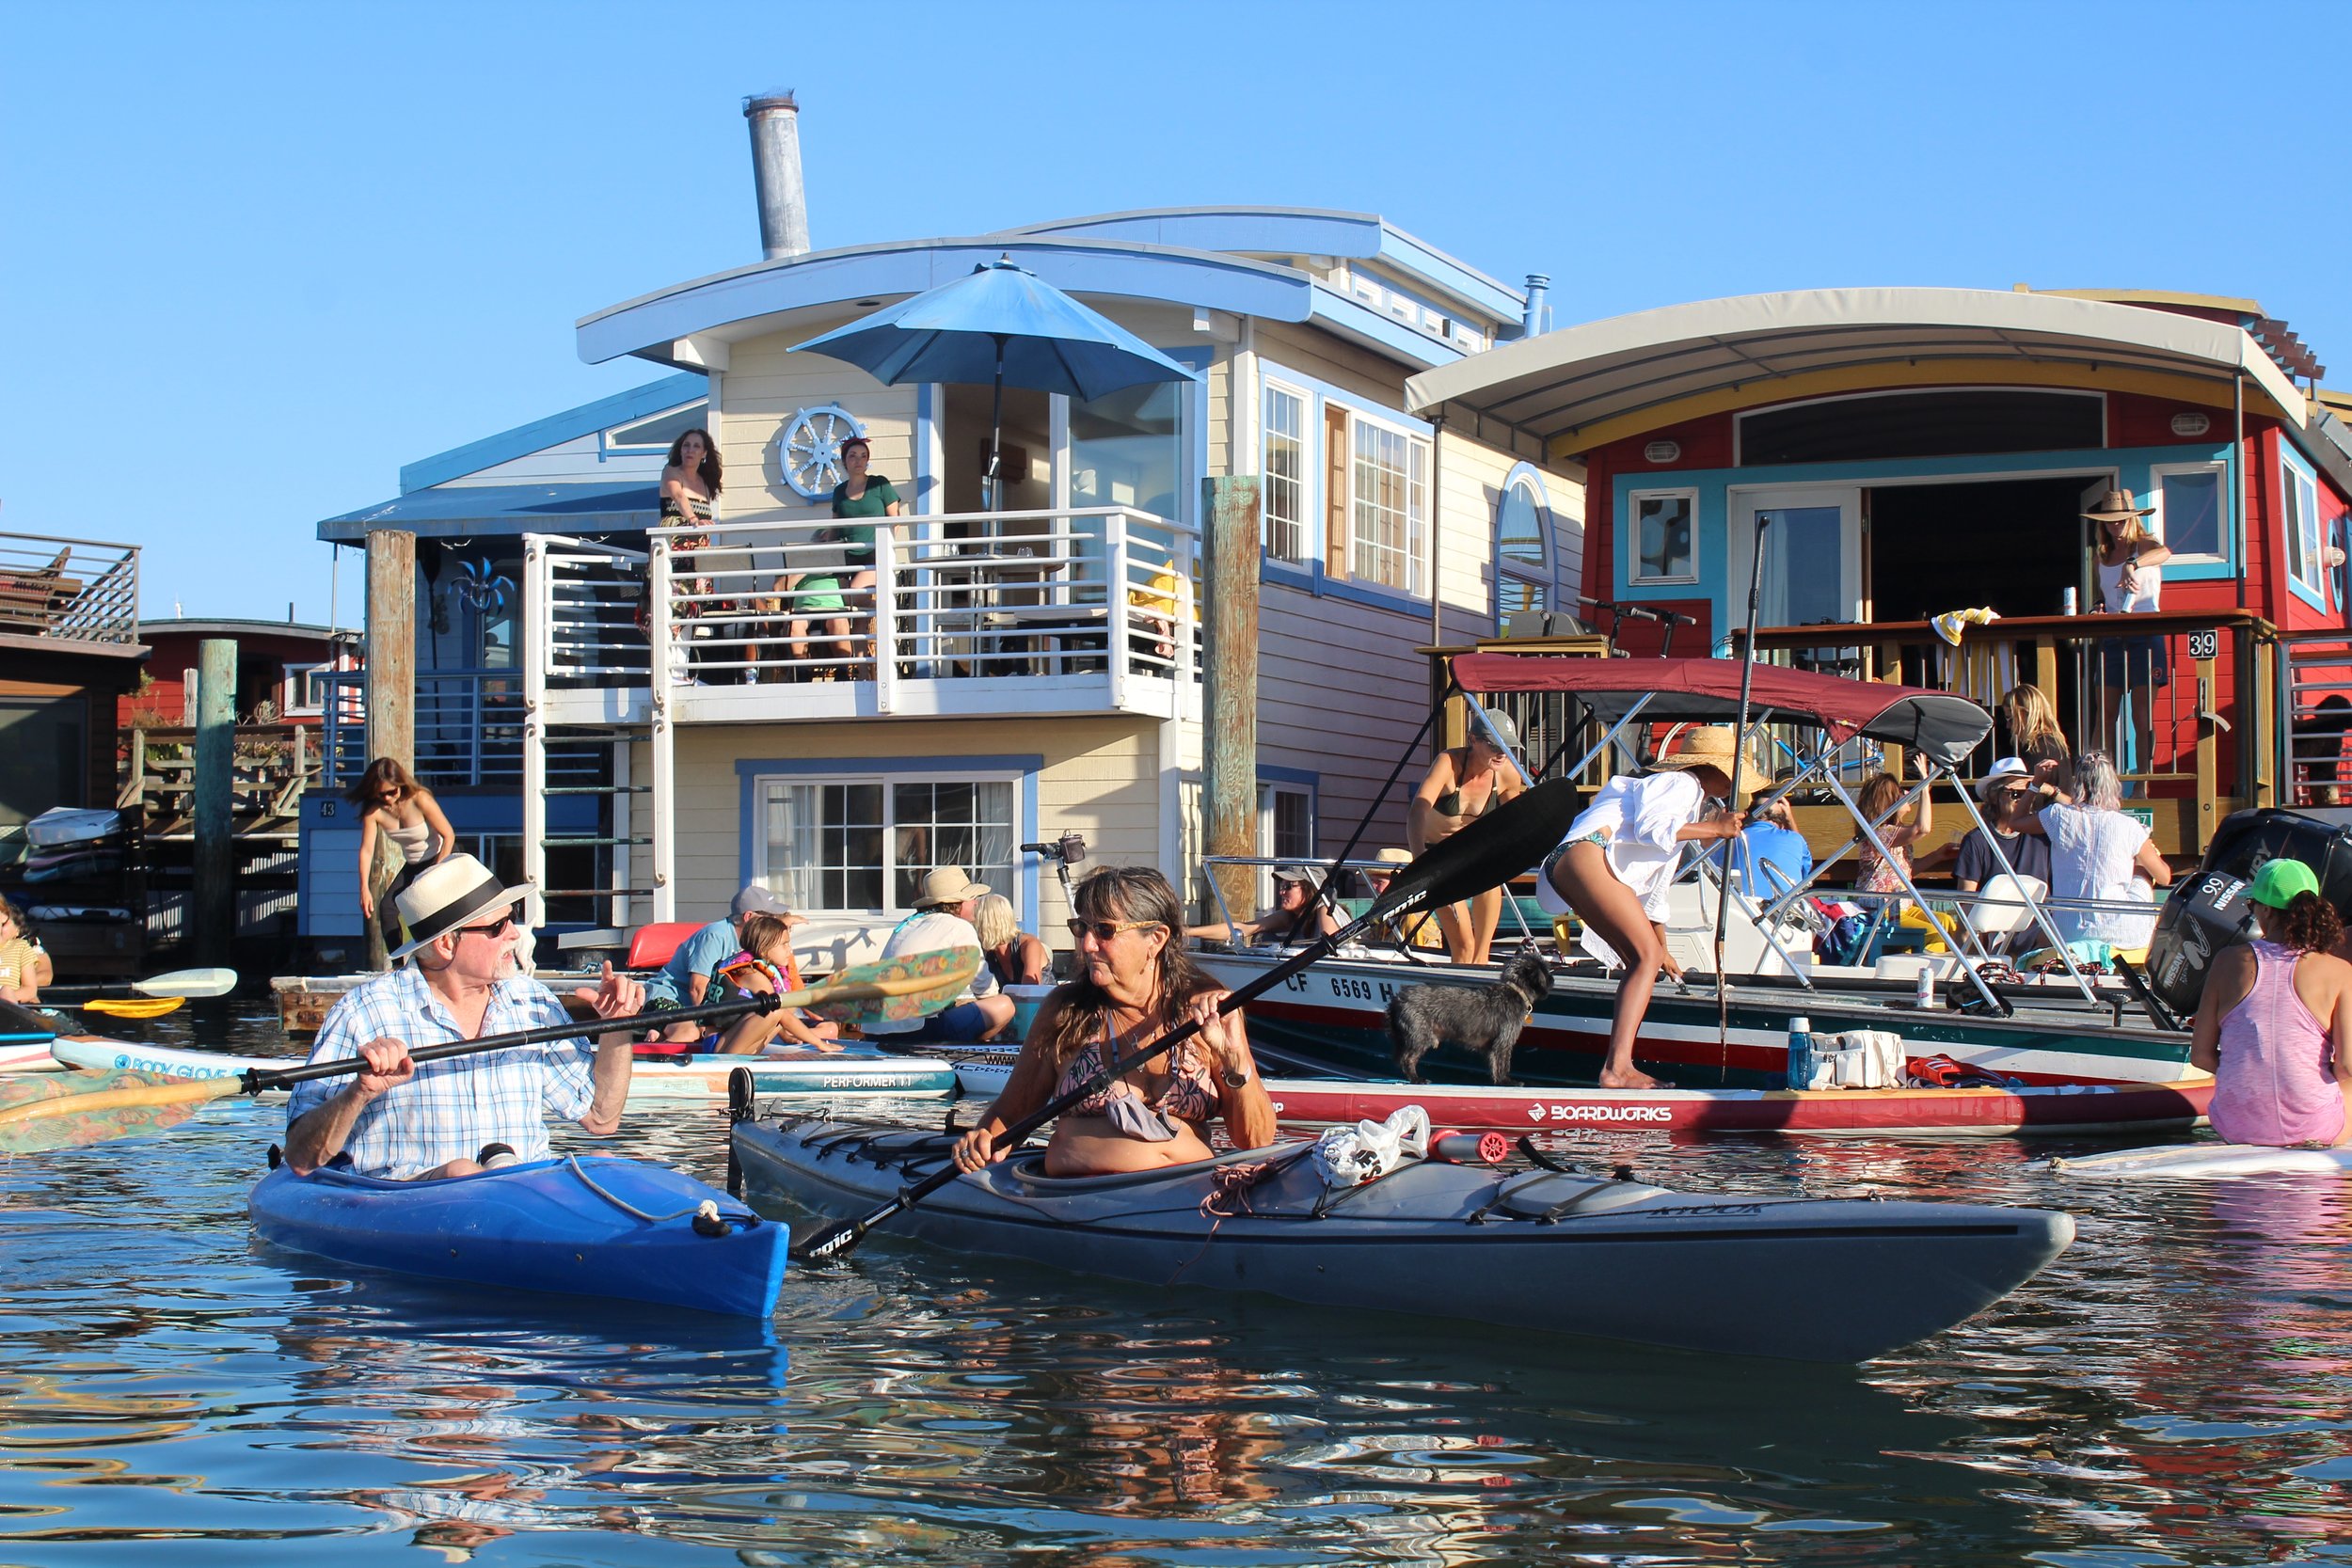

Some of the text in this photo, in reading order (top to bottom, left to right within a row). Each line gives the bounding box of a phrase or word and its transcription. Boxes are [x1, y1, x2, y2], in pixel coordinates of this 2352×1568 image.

[2190, 634, 2215, 655] 39
[321, 803, 335, 816] 43
[2213, 879, 2247, 911] NISSAN
[2164, 952, 2186, 988] NISSAN
[1286, 974, 1308, 992] CF
[1330, 977, 1372, 1000] 6569
[133, 1057, 175, 1074] BODY
[823, 1074, 897, 1087] PERFORMER
[1550, 1105, 1673, 1122] BOARDWORKS
